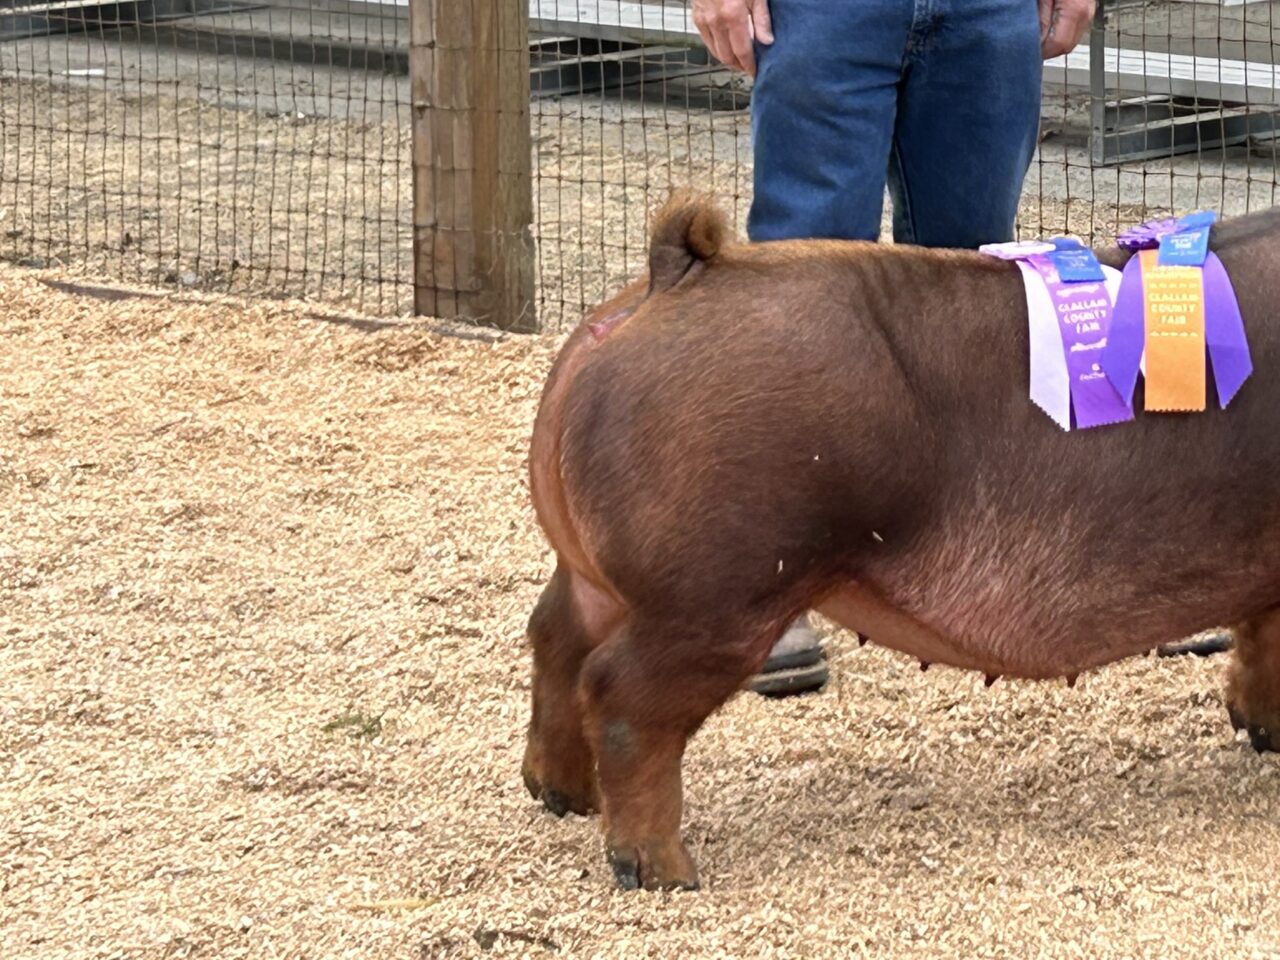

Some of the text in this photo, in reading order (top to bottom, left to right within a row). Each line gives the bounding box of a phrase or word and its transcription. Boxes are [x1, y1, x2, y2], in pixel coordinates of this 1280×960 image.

[1151, 303, 1196, 313] COUNTY
[1063, 309, 1106, 324] COUNTY
[1161, 315, 1187, 325] FAIR
[1076, 322, 1101, 334] FAIR
